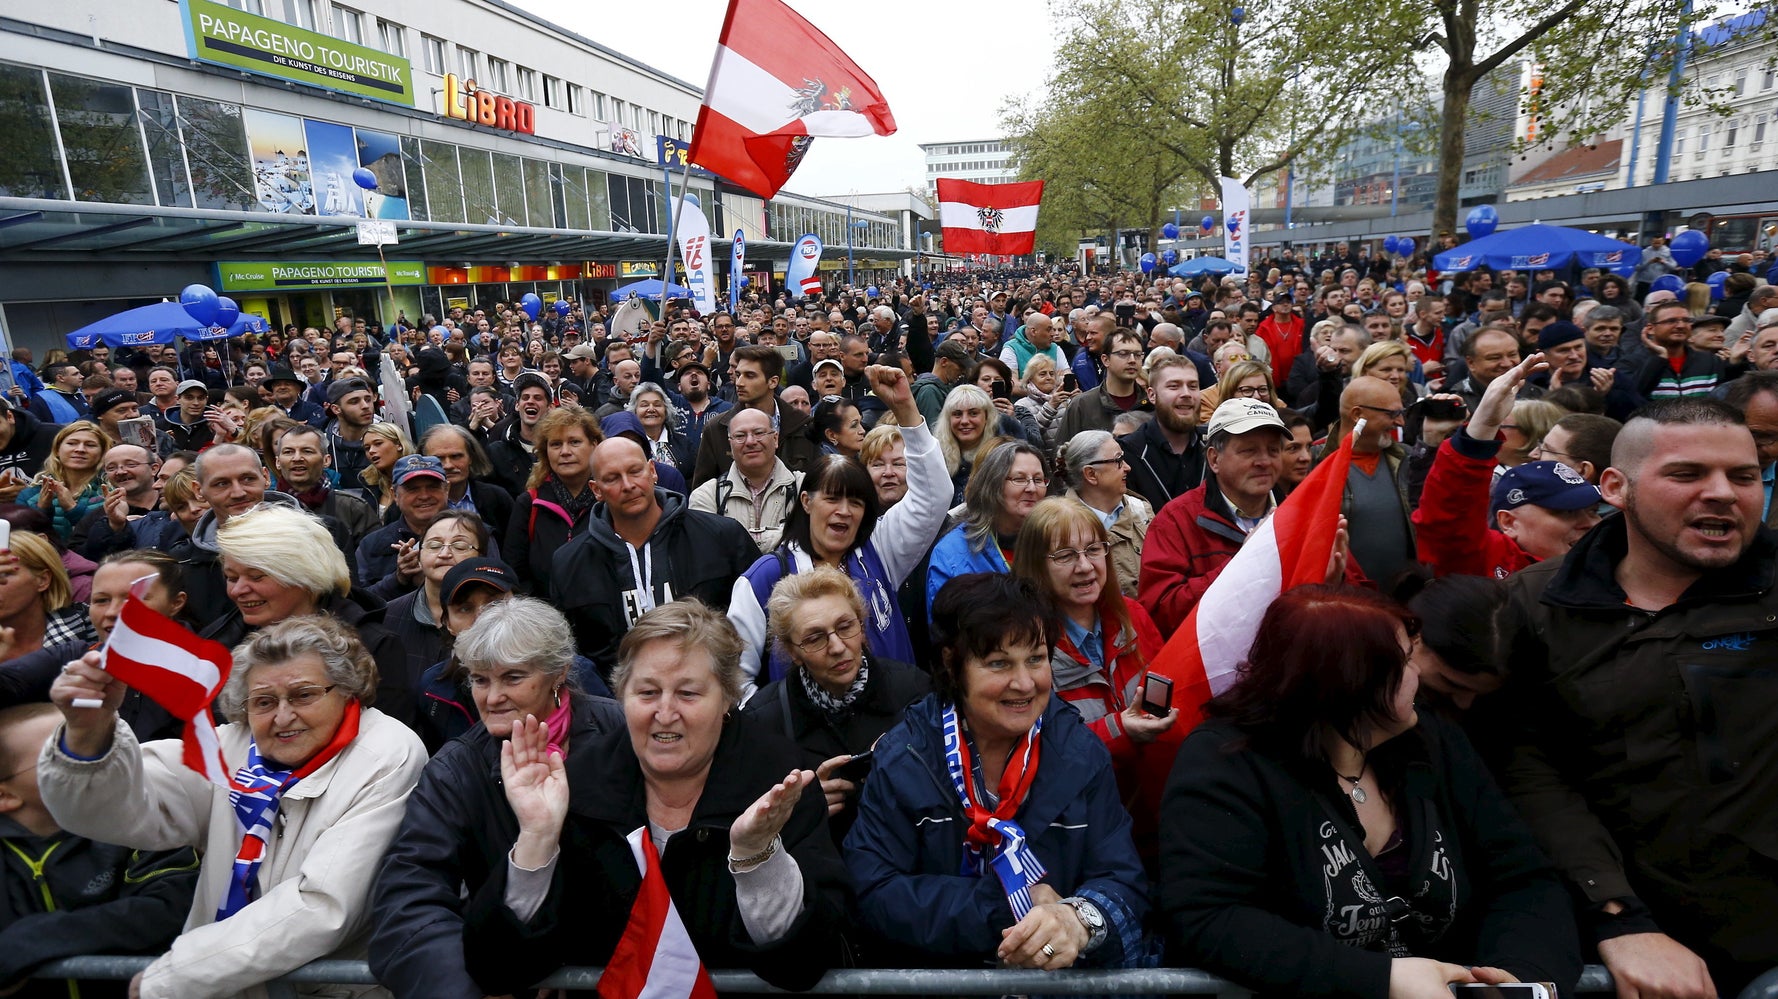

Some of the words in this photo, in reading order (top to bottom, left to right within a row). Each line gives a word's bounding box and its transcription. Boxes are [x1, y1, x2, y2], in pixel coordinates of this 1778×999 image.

[199, 13, 315, 61] PAPAGENO
[317, 46, 403, 83] TOURISTIK
[273, 55, 287, 65] DIE
[288, 60, 313, 72] KUNST
[314, 66, 327, 76] DES
[328, 69, 356, 82] REISENS
[272, 266, 335, 279] PAPAGENO
[338, 265, 386, 278] TOURISTIK
